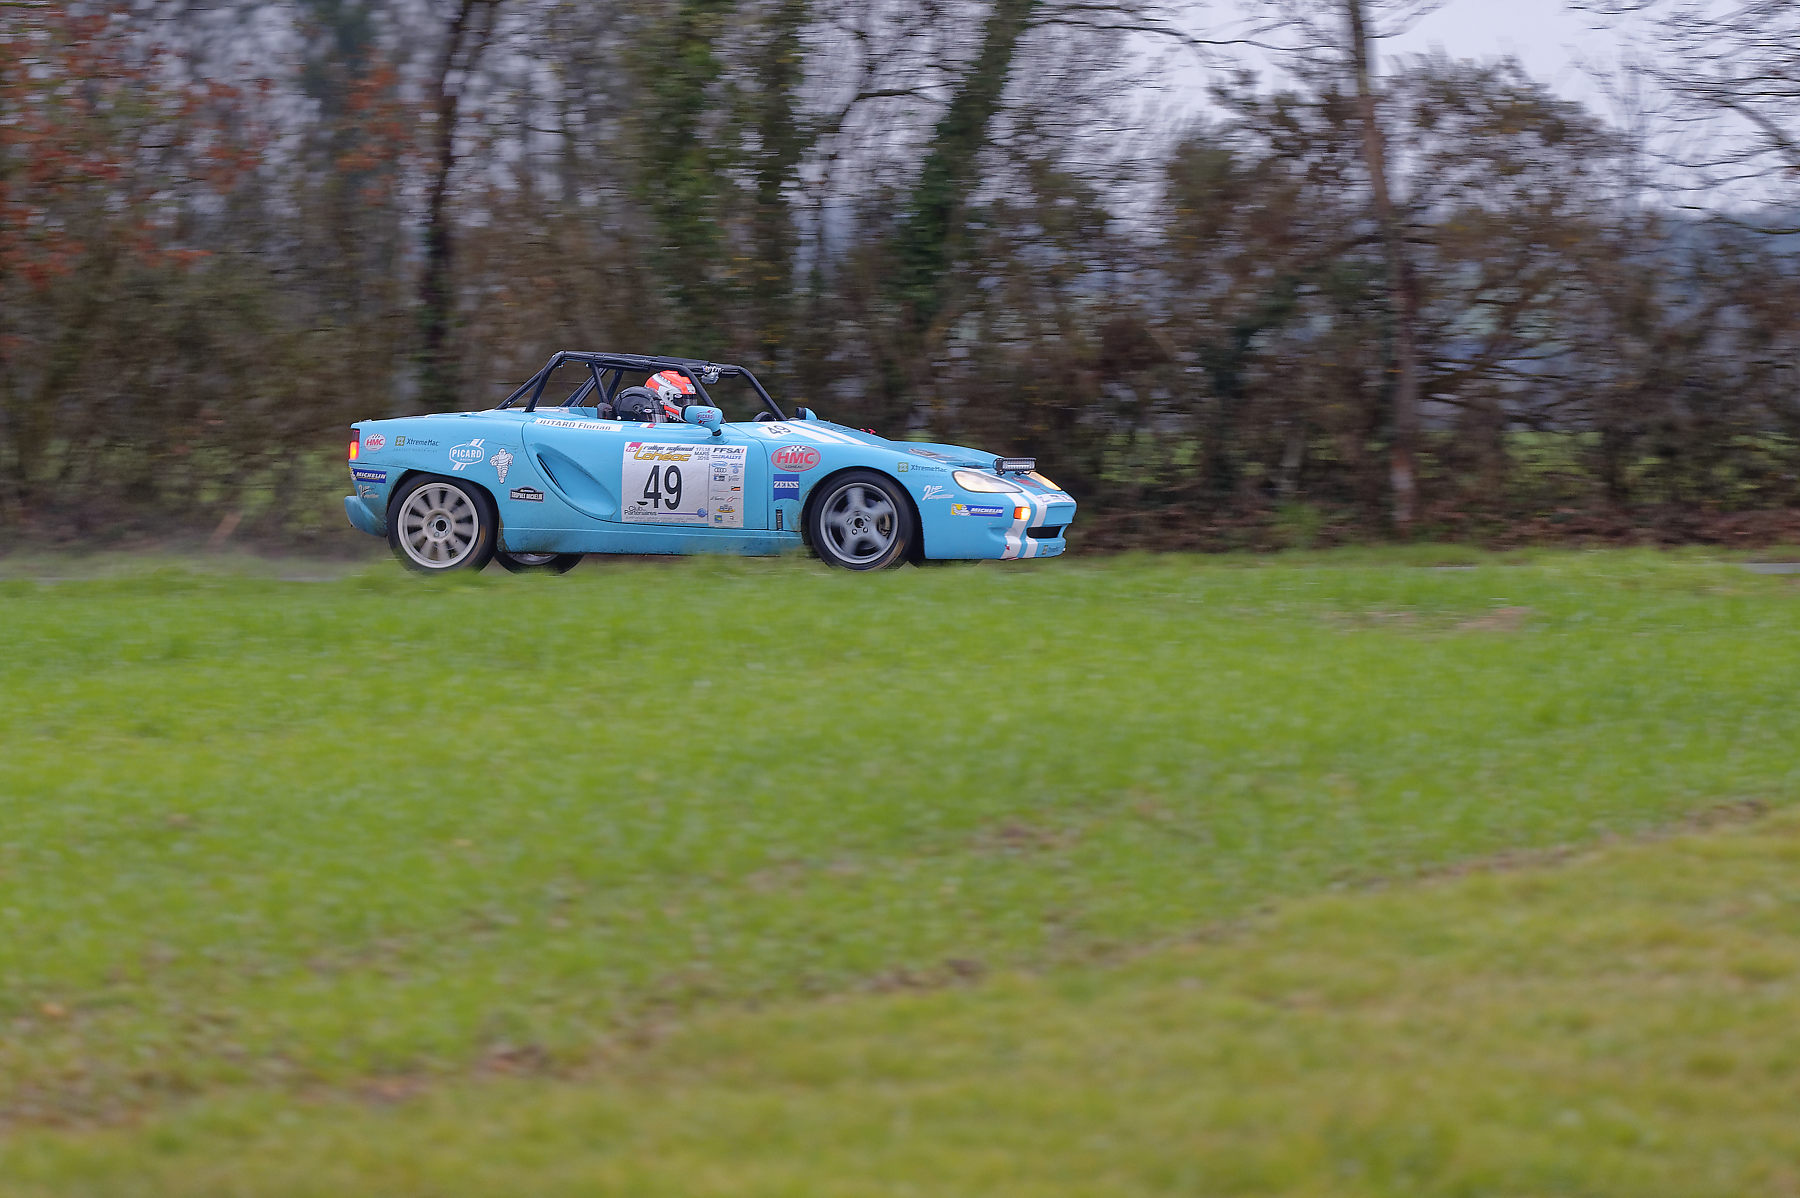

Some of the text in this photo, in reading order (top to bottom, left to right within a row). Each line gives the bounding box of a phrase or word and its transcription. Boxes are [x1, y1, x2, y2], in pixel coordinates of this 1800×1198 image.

[578, 422, 611, 431] Florian
[767, 424, 791, 435] 49
[366, 438, 384, 446] HMC
[406, 438, 440, 447] XtremeMac
[452, 449, 482, 458] PICARD
[776, 452, 815, 464] HMC
[356, 471, 386, 480] MICHELIN
[643, 465, 682, 510] 49
[774, 481, 799, 489] ZEISS
